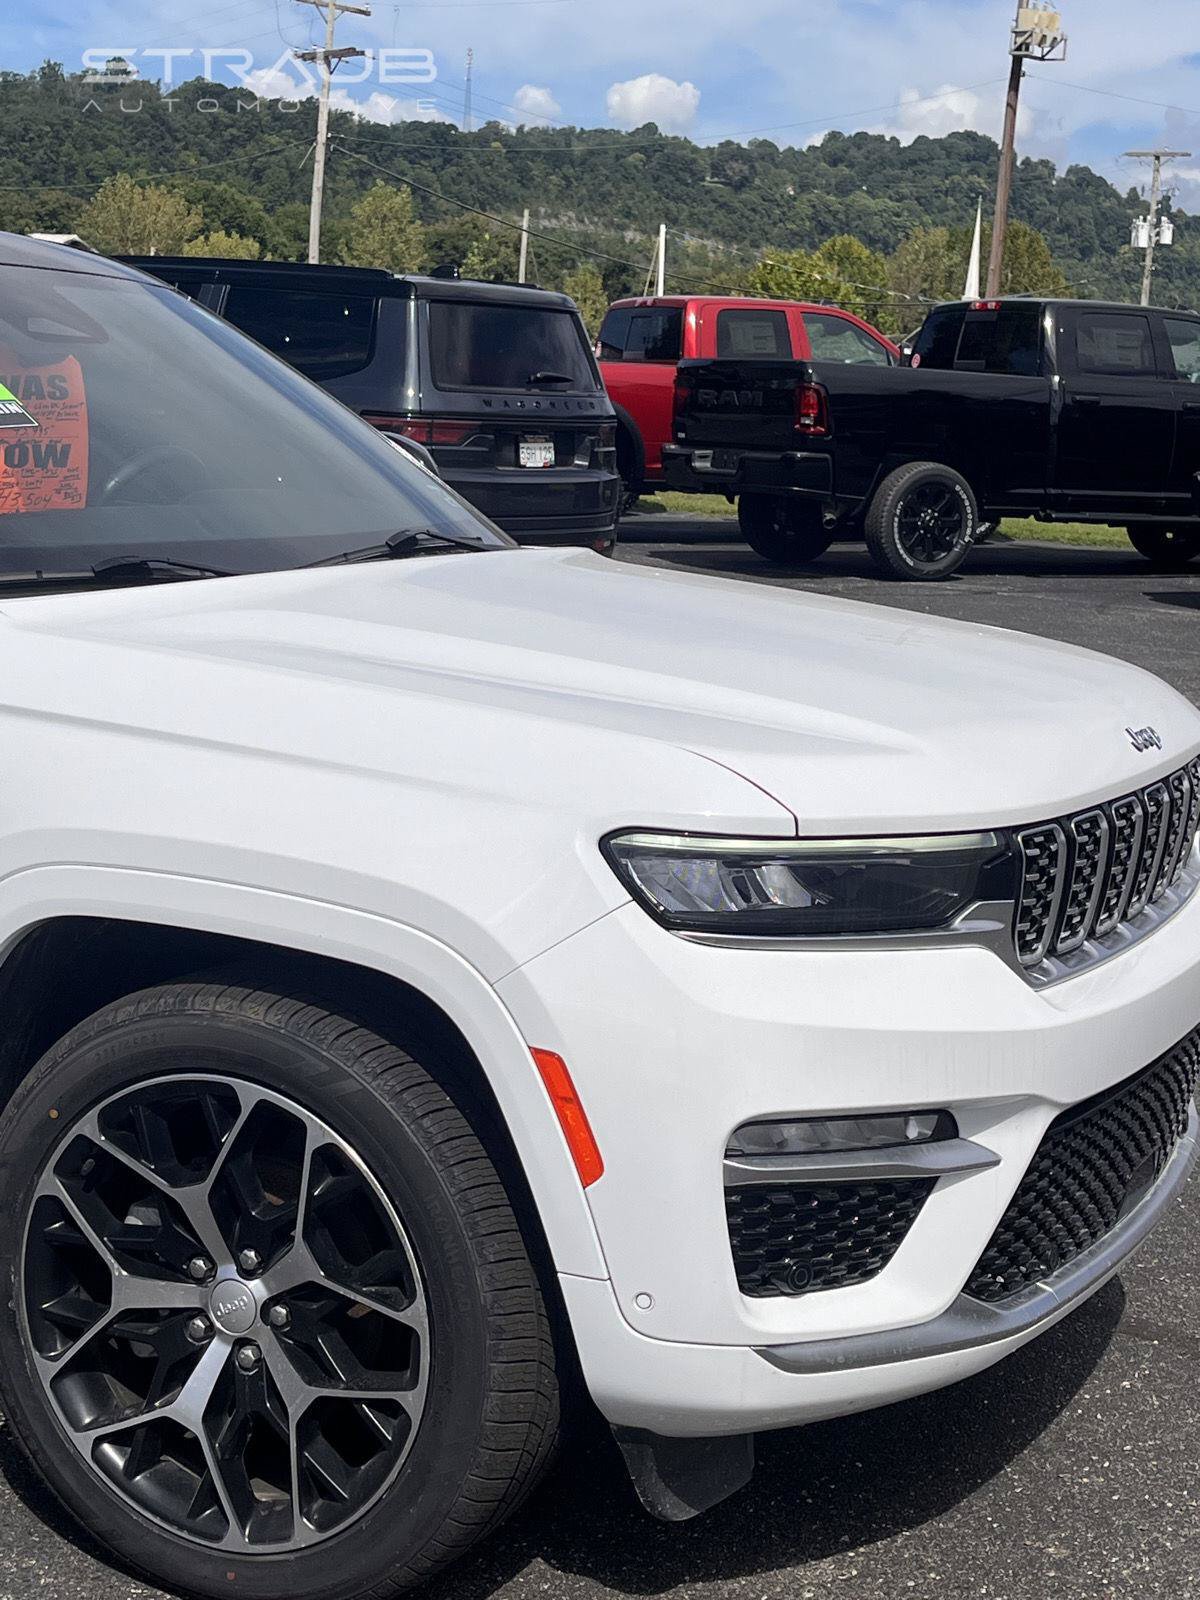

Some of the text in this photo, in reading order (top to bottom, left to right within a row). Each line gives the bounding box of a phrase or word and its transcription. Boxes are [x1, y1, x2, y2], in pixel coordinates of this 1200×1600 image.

[698, 388, 763, 406] RAM
[3, 443, 72, 468] OW
[1125, 726, 1162, 752] Jeep
[216, 1295, 248, 1317] Jeep
